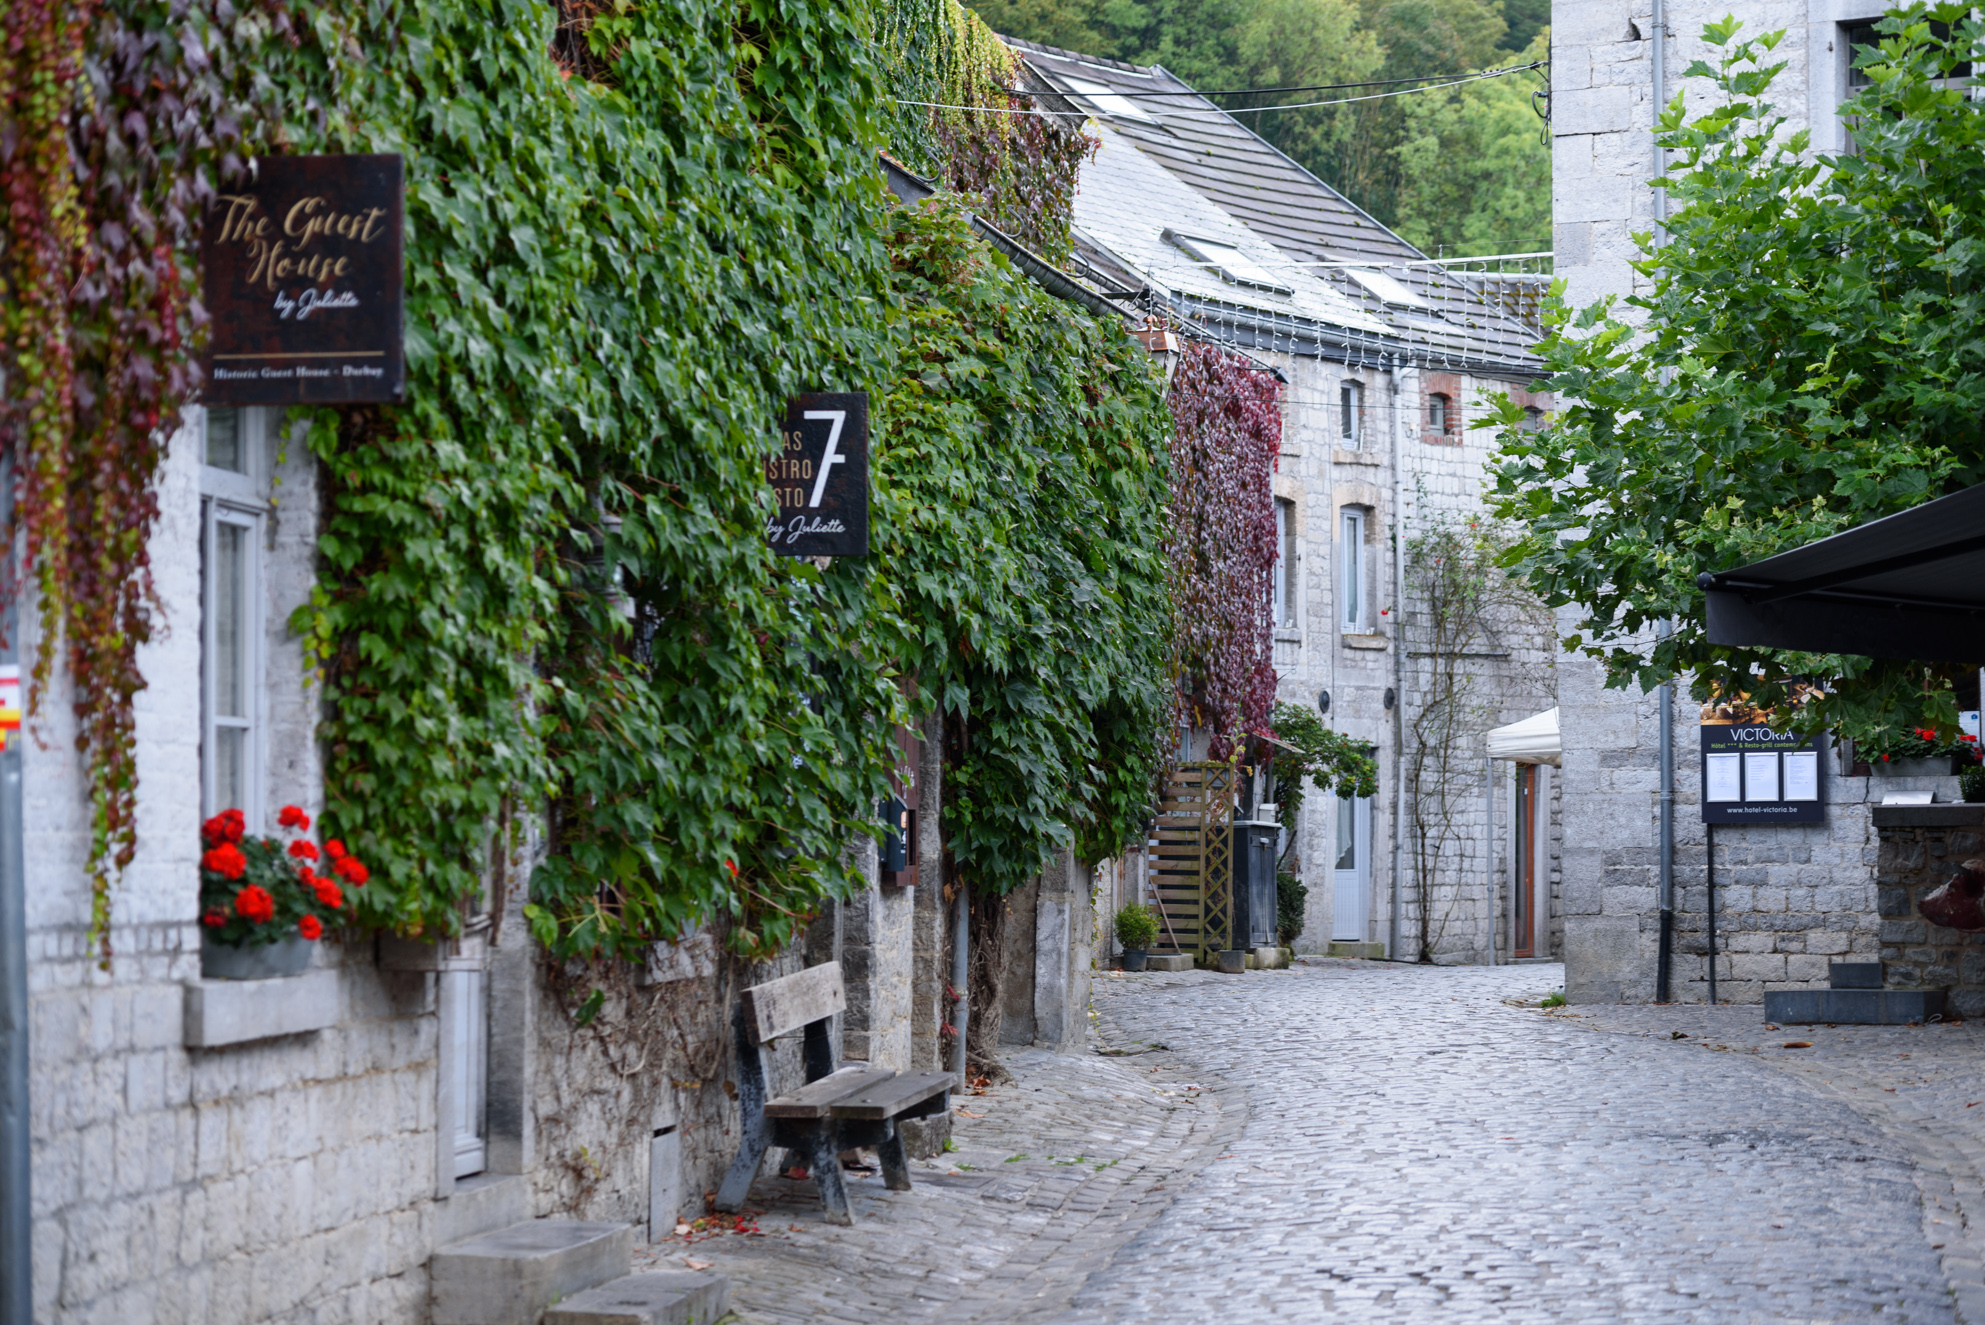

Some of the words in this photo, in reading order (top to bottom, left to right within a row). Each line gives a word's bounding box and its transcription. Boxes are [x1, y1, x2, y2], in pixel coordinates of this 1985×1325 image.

[214, 194, 273, 244] The
[284, 196, 387, 250] Guest
[246, 239, 350, 291] House
[273, 290, 295, 319] by
[296, 288, 360, 320] Juliette
[213, 368, 258, 380] Historic
[260, 366, 294, 379] Guest
[295, 365, 329, 378] House
[782, 431, 803, 451] AS
[763, 459, 812, 479] ISTRO
[803, 410, 846, 508] 7
[767, 516, 785, 542] by
[786, 515, 846, 544] Juliette
[1744, 741, 1773, 750] Resto-grill
